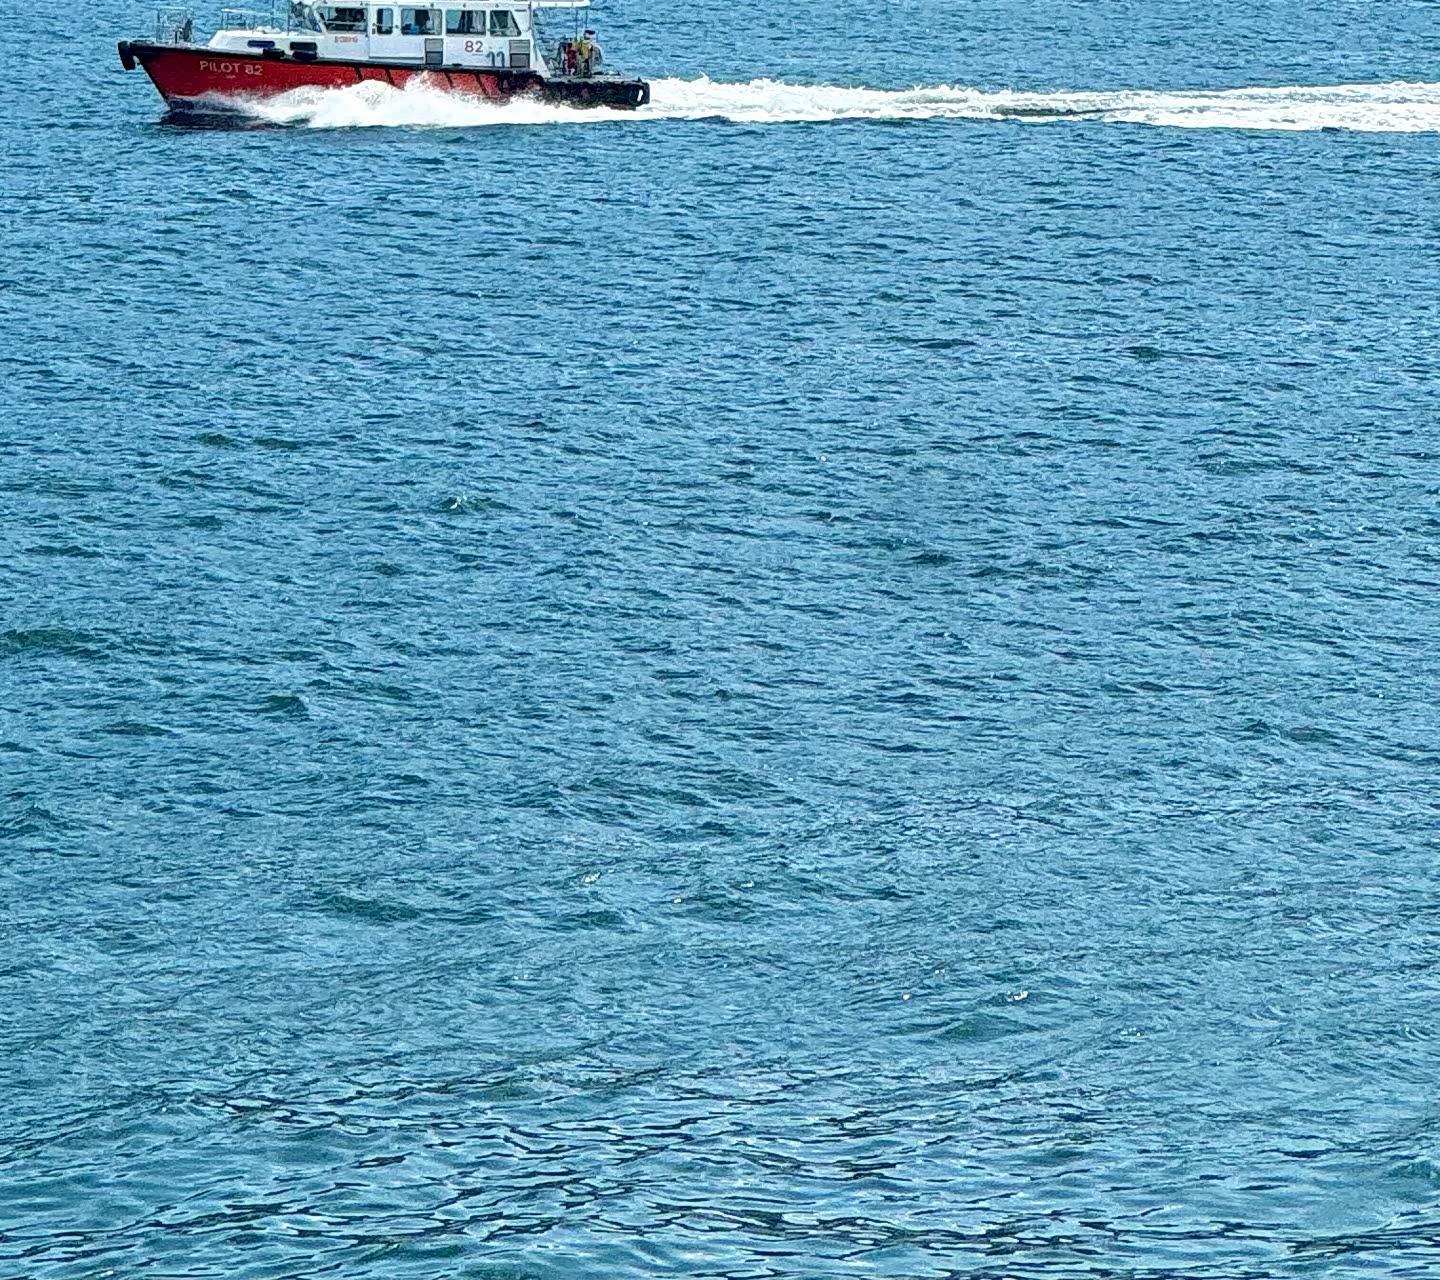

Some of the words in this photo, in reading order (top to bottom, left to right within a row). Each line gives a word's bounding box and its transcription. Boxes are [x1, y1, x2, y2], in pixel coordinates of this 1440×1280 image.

[464, 40, 483, 53] 82
[199, 60, 241, 73] PILOT
[244, 64, 263, 76] 82
